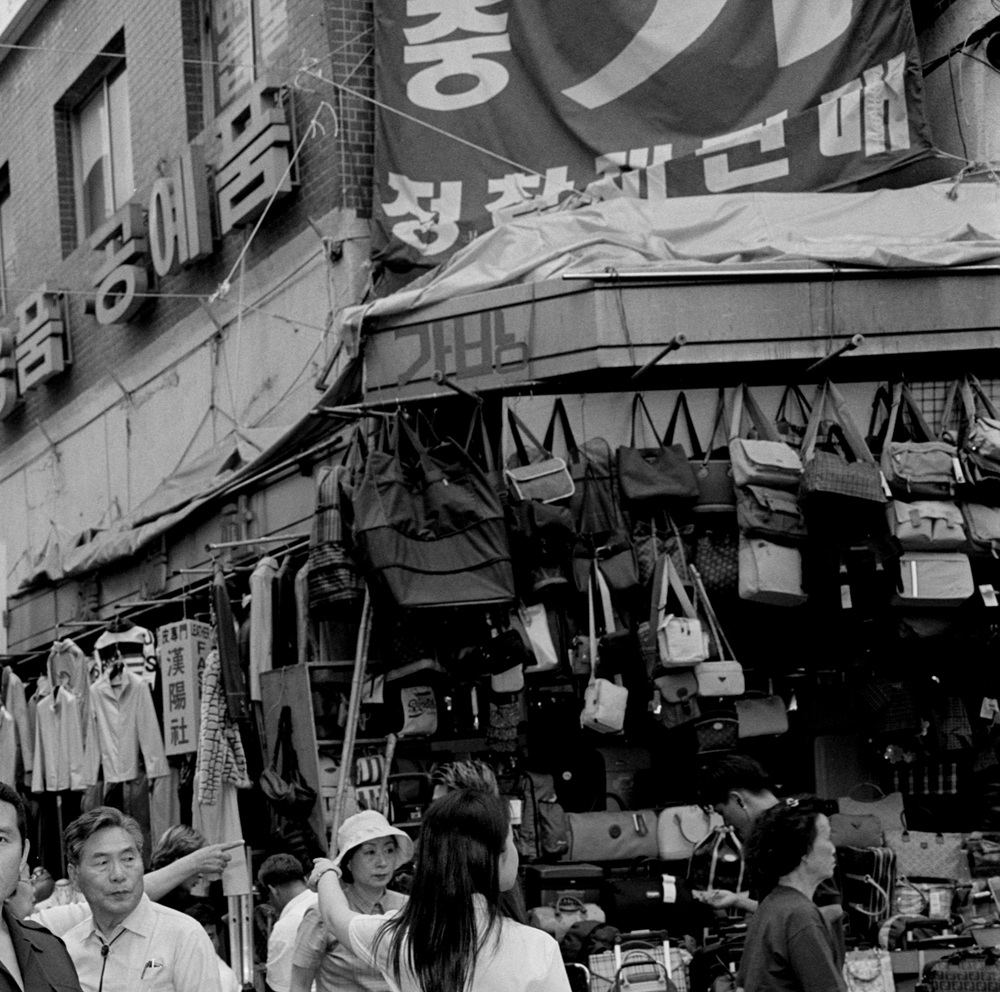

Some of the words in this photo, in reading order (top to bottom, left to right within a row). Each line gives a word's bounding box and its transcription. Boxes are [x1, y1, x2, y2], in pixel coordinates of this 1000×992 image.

[90, 75, 290, 326] 공예품
[394, 310, 528, 390] 가방
[166, 646, 190, 746] 漢陽社
